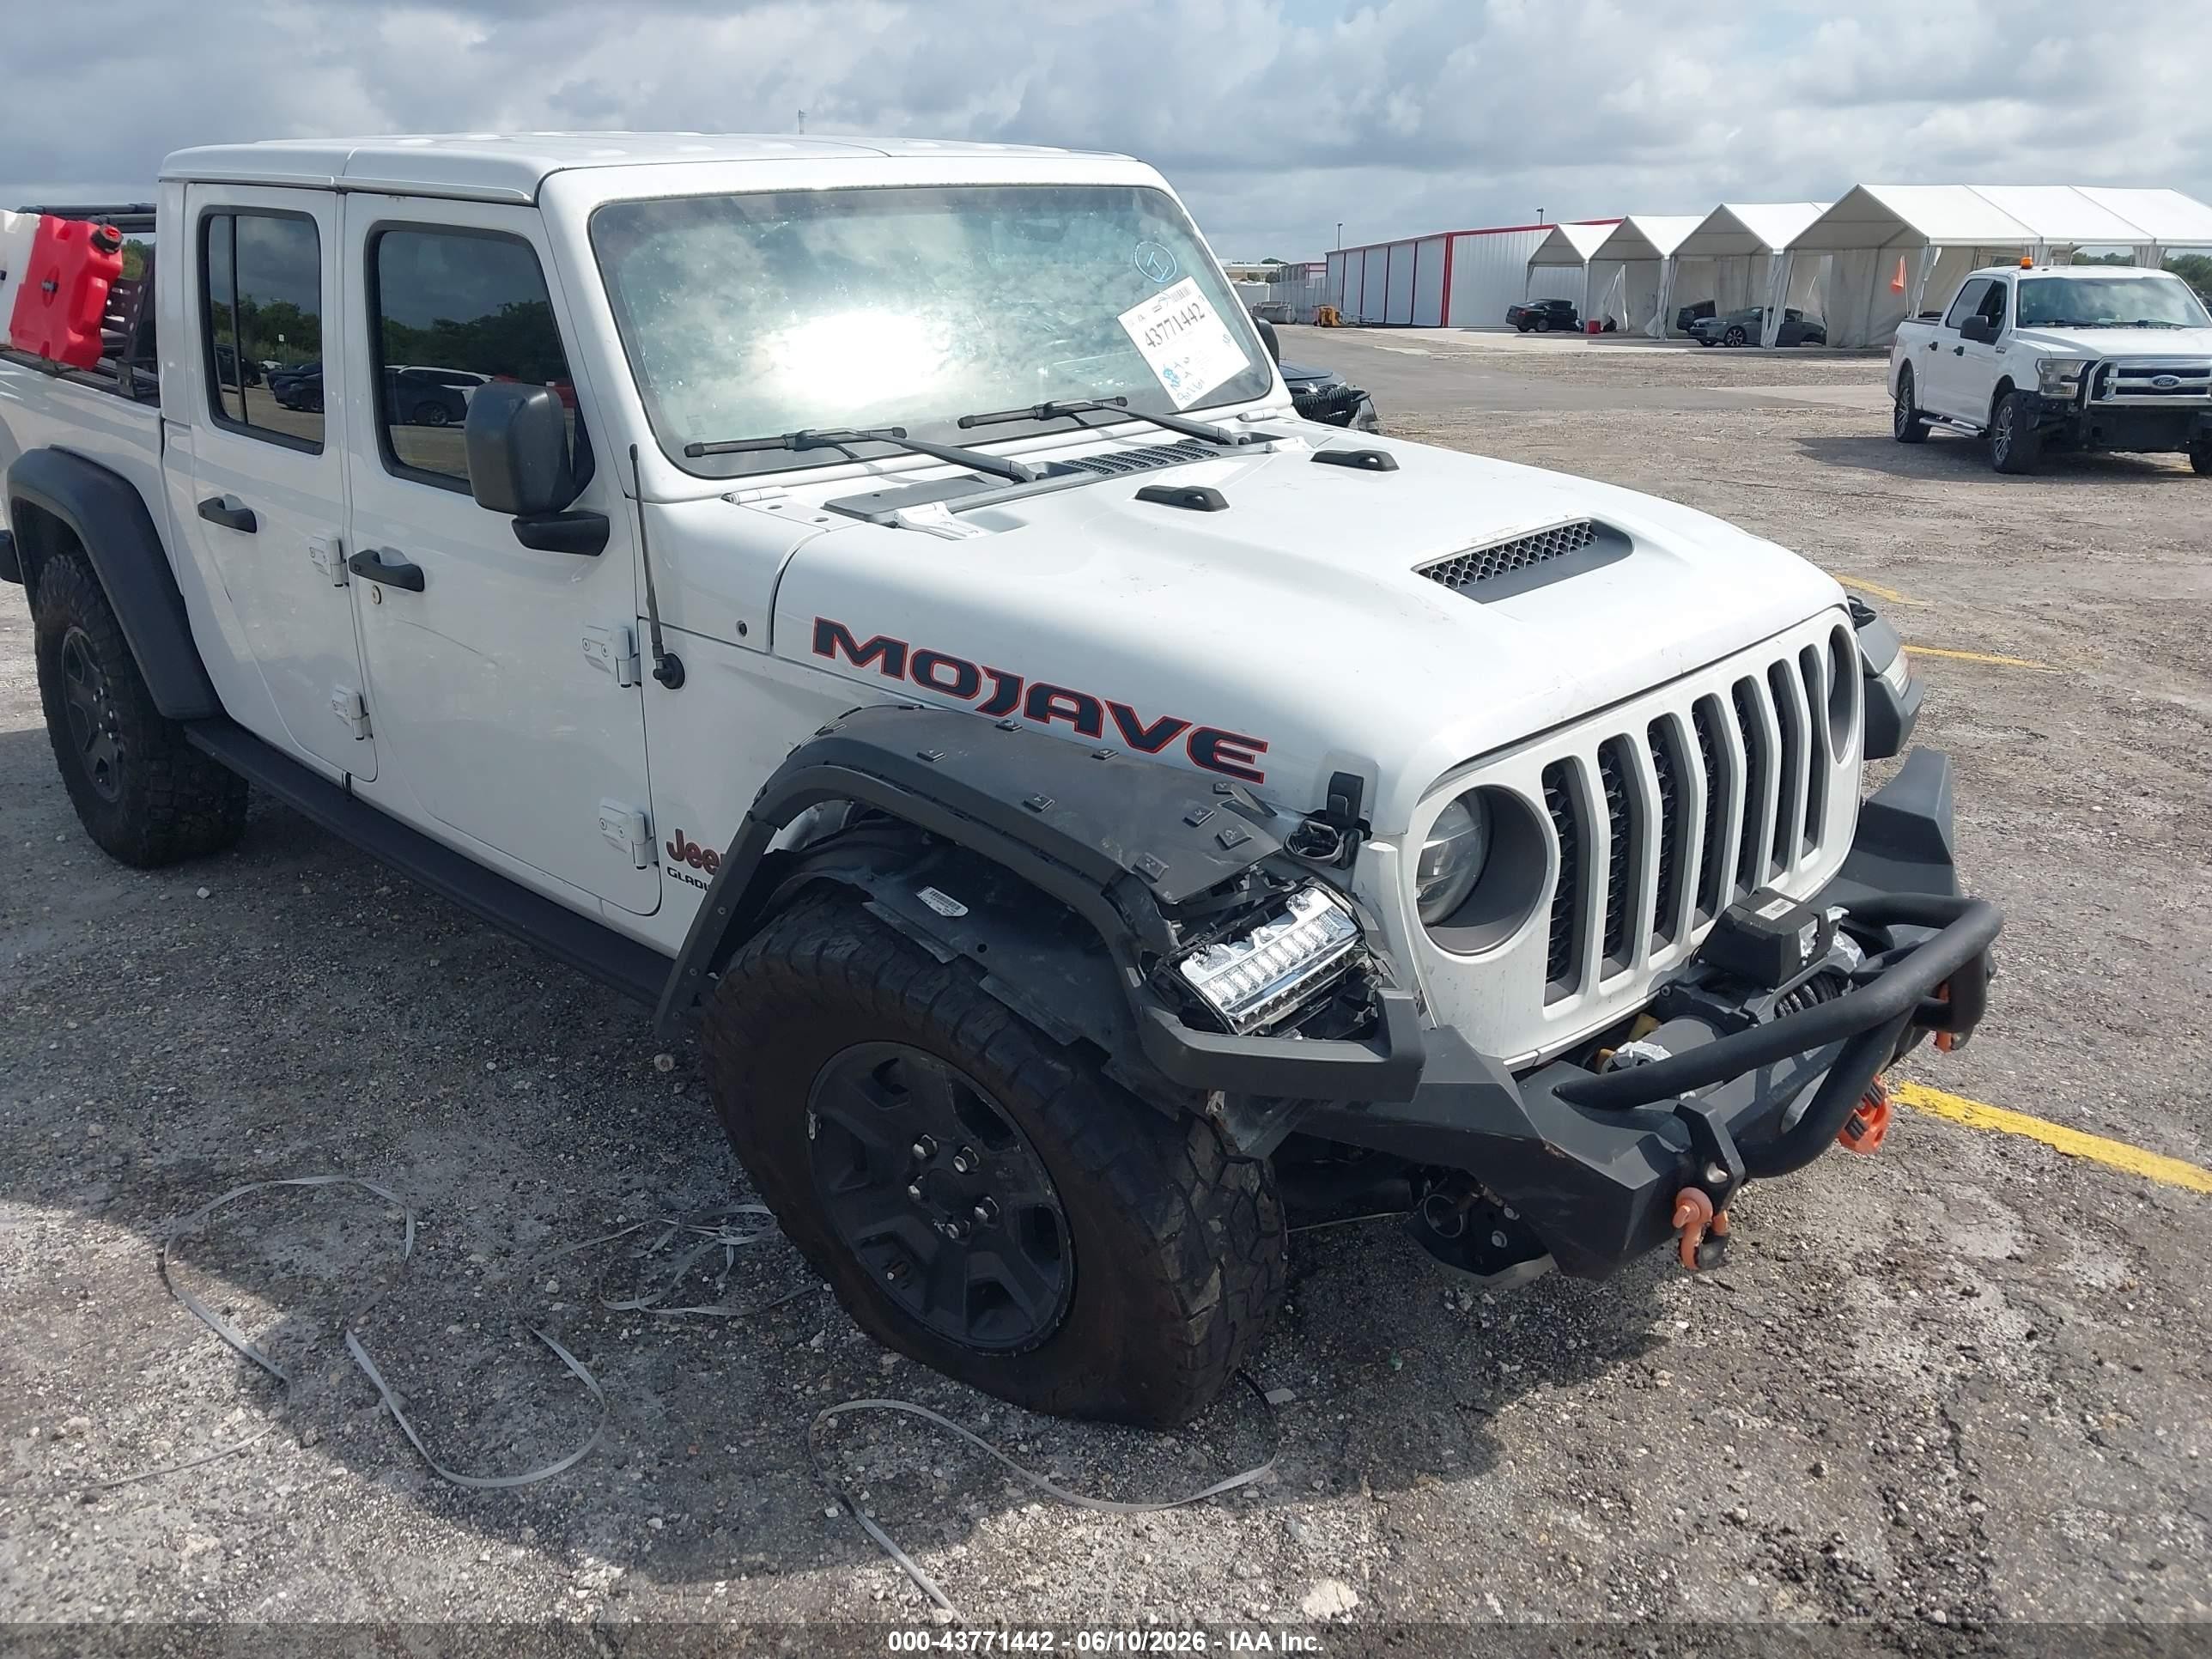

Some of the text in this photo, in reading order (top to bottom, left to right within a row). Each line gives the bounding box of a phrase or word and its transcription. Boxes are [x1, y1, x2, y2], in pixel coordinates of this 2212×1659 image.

[1144, 302, 1206, 348] 43771442
[812, 616, 1269, 783] MOJAVE
[665, 828, 726, 876] Jee
[666, 866, 710, 891] GLADI
